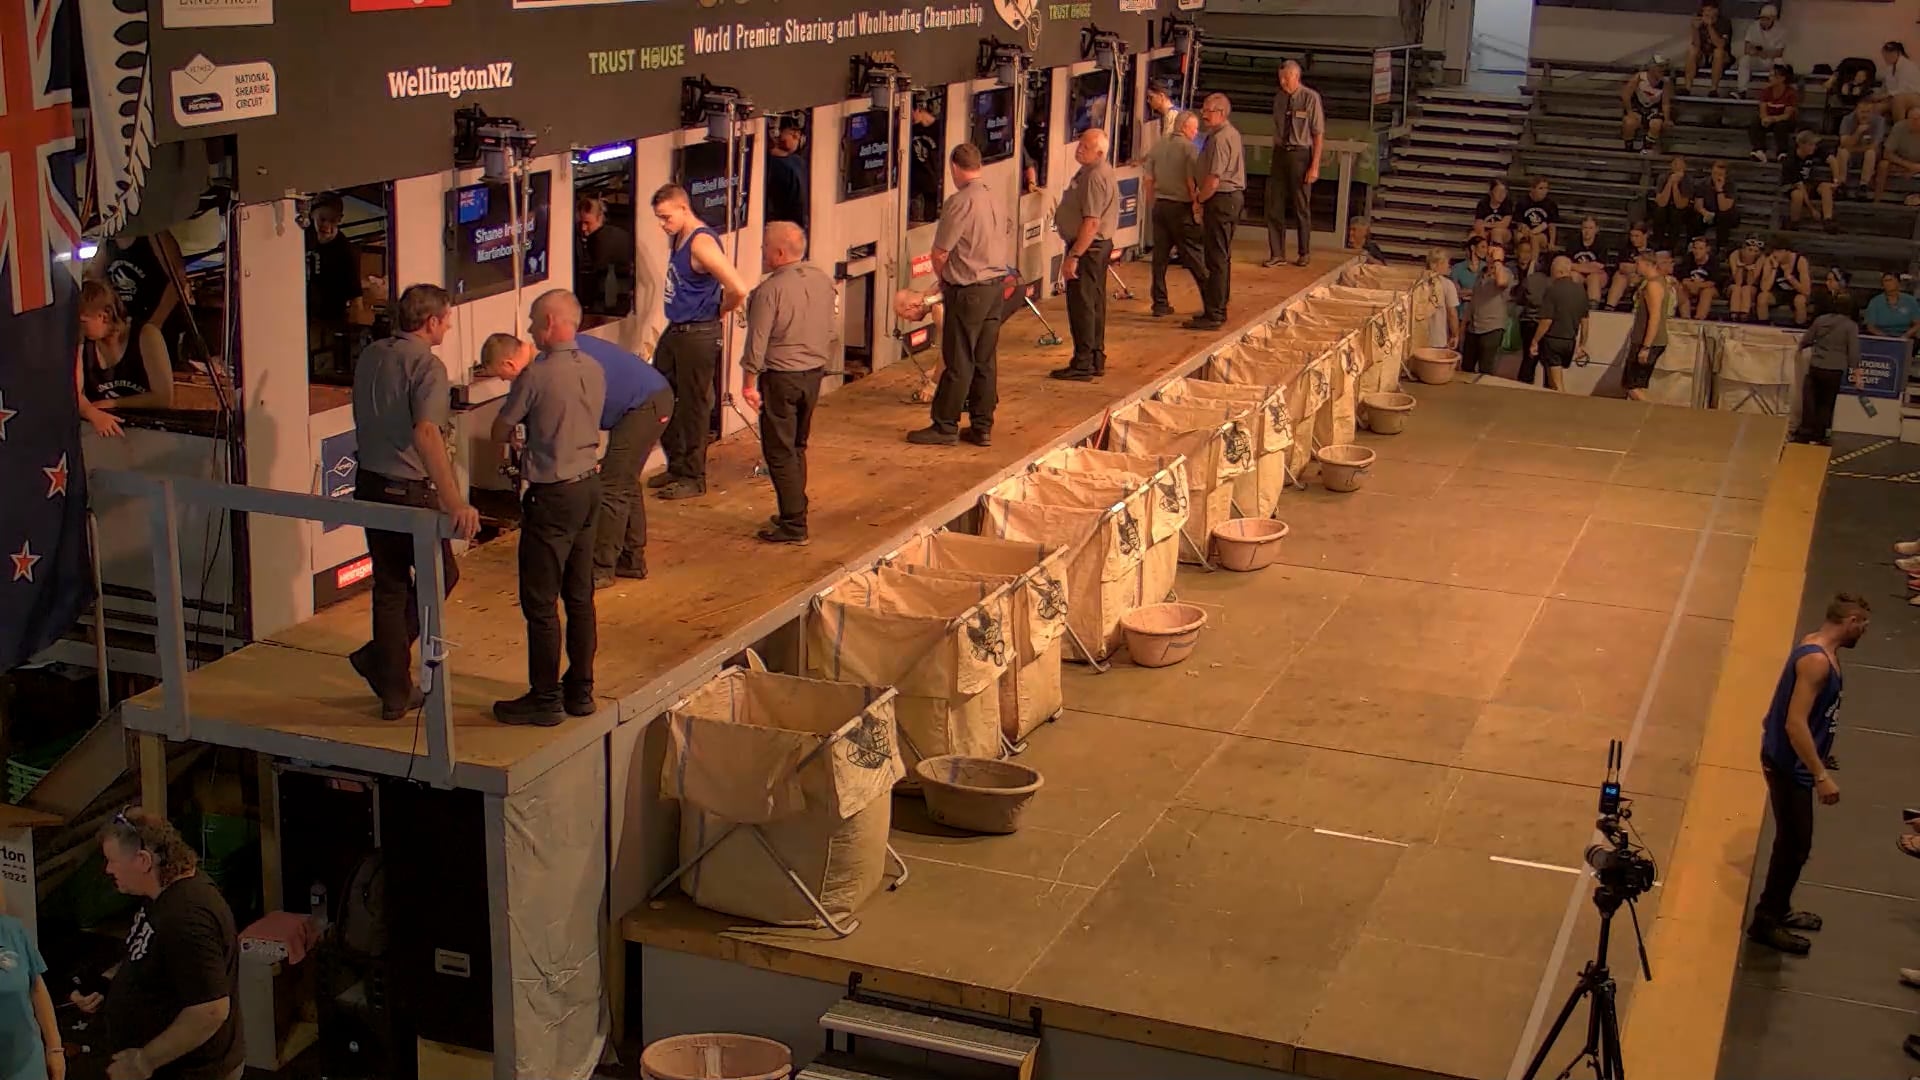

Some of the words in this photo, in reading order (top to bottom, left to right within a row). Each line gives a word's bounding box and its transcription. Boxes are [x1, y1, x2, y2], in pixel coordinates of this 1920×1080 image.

[693, 25, 731, 54] World
[736, 22, 781, 49] Premier
[785, 17, 834, 44] Shearing
[837, 13, 855, 38] and
[858, 8, 922, 35] Woolhandling
[924, 3, 984, 30] Championship
[589, 50, 635, 74] TRUST
[641, 45, 685, 69] HOUSE
[235, 73, 269, 85] NATIONAL
[388, 62, 513, 99] WellingtonNZ
[235, 85, 270, 97] SHEARING
[236, 97, 263, 109] CIRCUIT
[475, 229, 503, 243] Shane
[538, 250, 546, 273] 1
